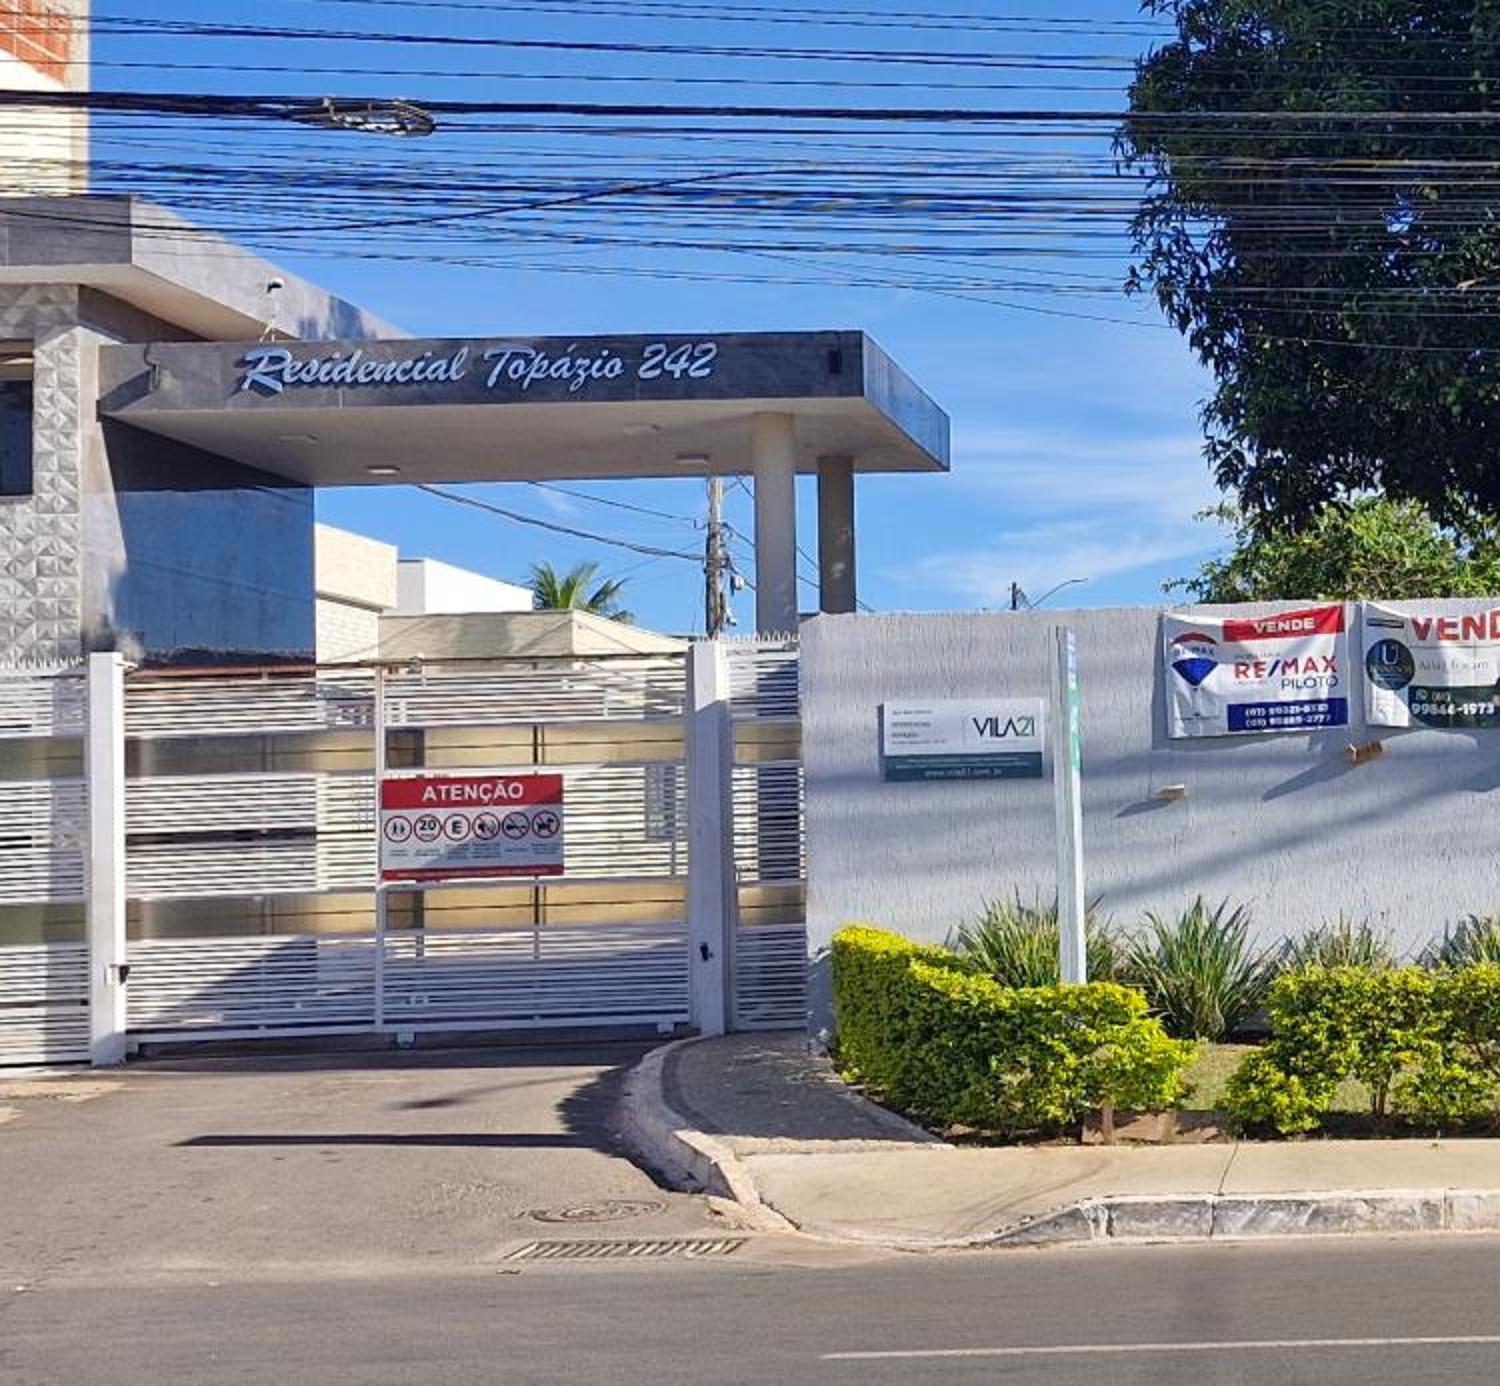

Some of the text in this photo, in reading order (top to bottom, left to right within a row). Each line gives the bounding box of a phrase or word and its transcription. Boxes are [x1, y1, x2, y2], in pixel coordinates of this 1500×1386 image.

[242, 342, 718, 393] Residencial Topázio 242
[1253, 617, 1315, 634] VENDE
[1234, 655, 1338, 680] RE/MAX
[1281, 674, 1339, 691] PILOTO
[972, 715, 1036, 739] VILA21
[421, 779, 525, 804] ATENÇÃO
[420, 819, 437, 831] 20
[451, 820, 462, 835] E
